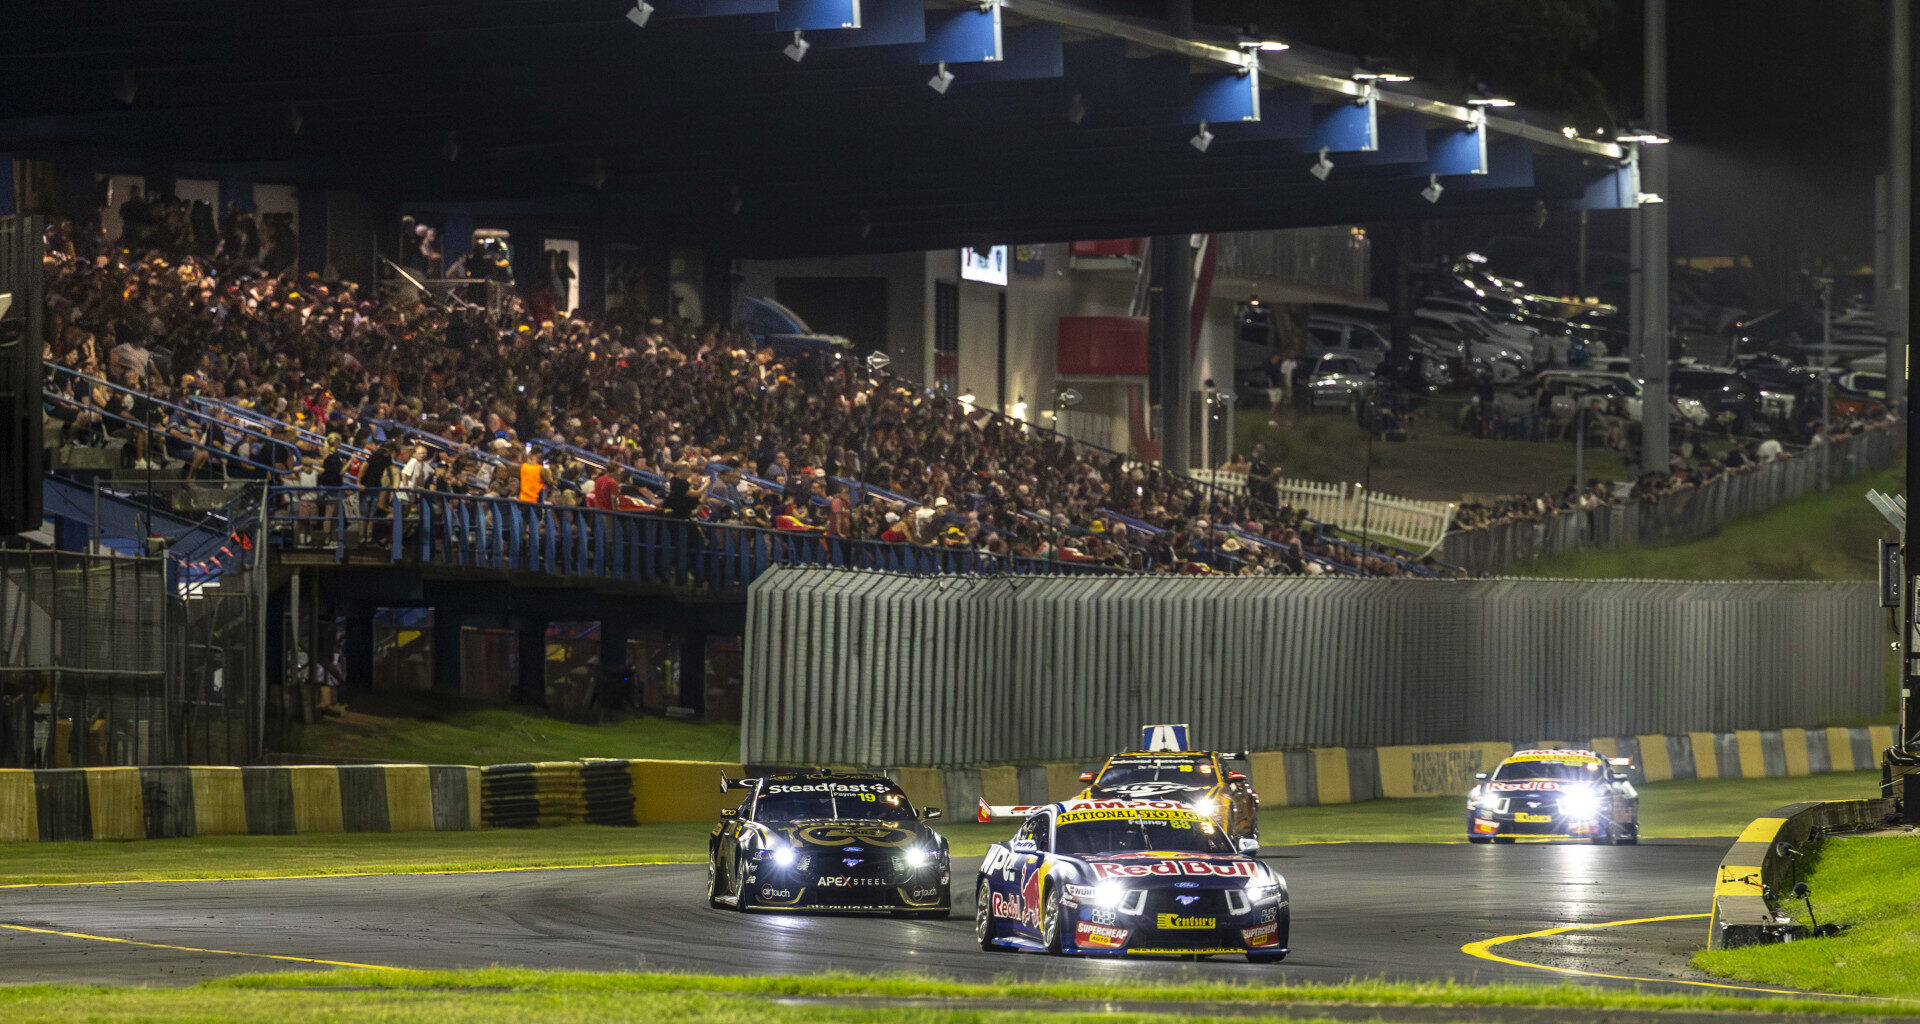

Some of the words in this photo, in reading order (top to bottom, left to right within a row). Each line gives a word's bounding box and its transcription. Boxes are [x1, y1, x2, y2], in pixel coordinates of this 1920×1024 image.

[1178, 764, 1193, 773] 18
[768, 783, 869, 794] Steadfast
[857, 793, 876, 802] 19
[1070, 801, 1197, 811] AMPOL
[1061, 811, 1137, 823] NATIONAL
[1170, 820, 1191, 830] 88
[1200, 822, 1214, 835] 3
[1090, 861, 1182, 880] Red
[1180, 860, 1258, 878] Bull
[817, 875, 852, 888] APEX
[853, 878, 887, 886] STEEL
[762, 888, 790, 898] airtouch
[993, 892, 1014, 918] Red
[1171, 914, 1217, 930] Century
[1077, 922, 1128, 940] SUPERCHEAP
[1243, 922, 1278, 940] SUPERCHEAP
